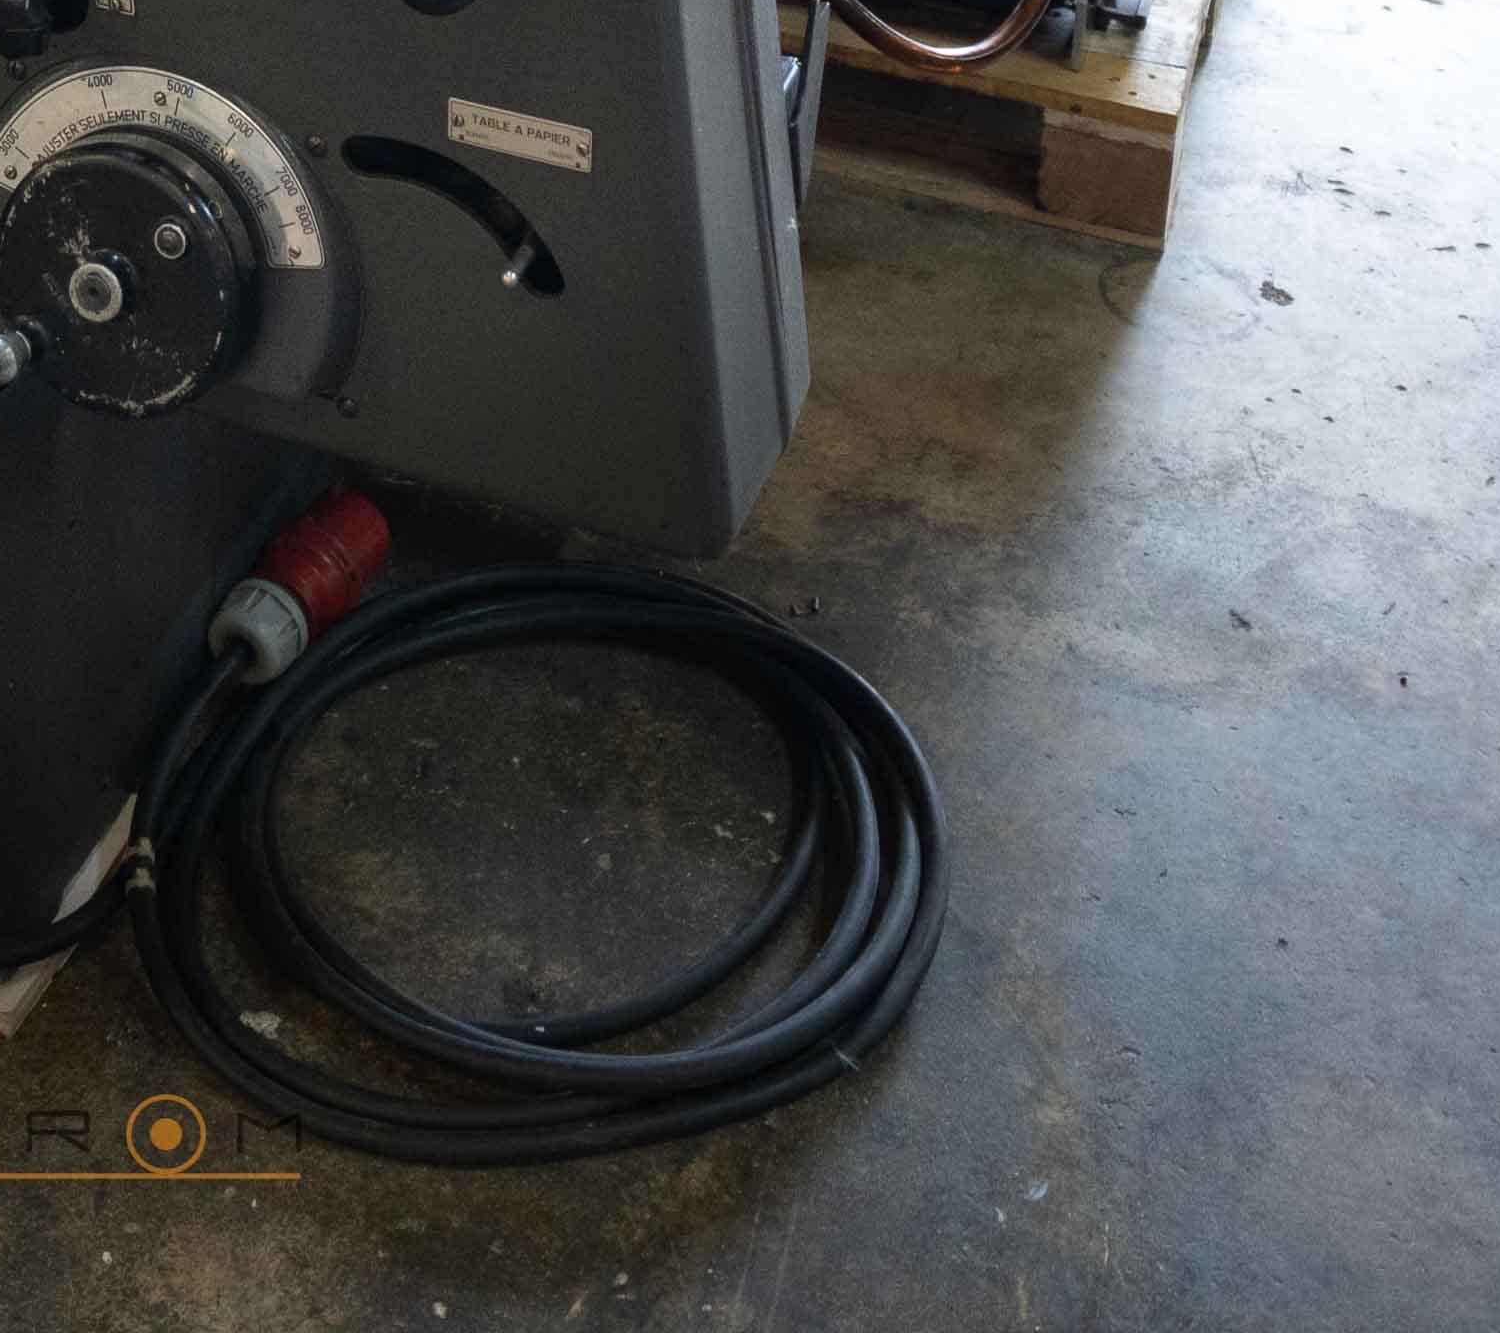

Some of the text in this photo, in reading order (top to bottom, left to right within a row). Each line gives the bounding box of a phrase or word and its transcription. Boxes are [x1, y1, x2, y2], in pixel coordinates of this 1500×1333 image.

[87, 74, 113, 89] 4000
[166, 79, 194, 99] 5000
[226, 112, 255, 139] 6000
[471, 112, 512, 133] TABLE
[526, 127, 571, 147] PAPIER
[32, 110, 269, 213] AJUSTER SEULEMENT SI PRESSE EN MARCHE
[275, 168, 298, 198] 7000
[295, 204, 314, 236] 8000
